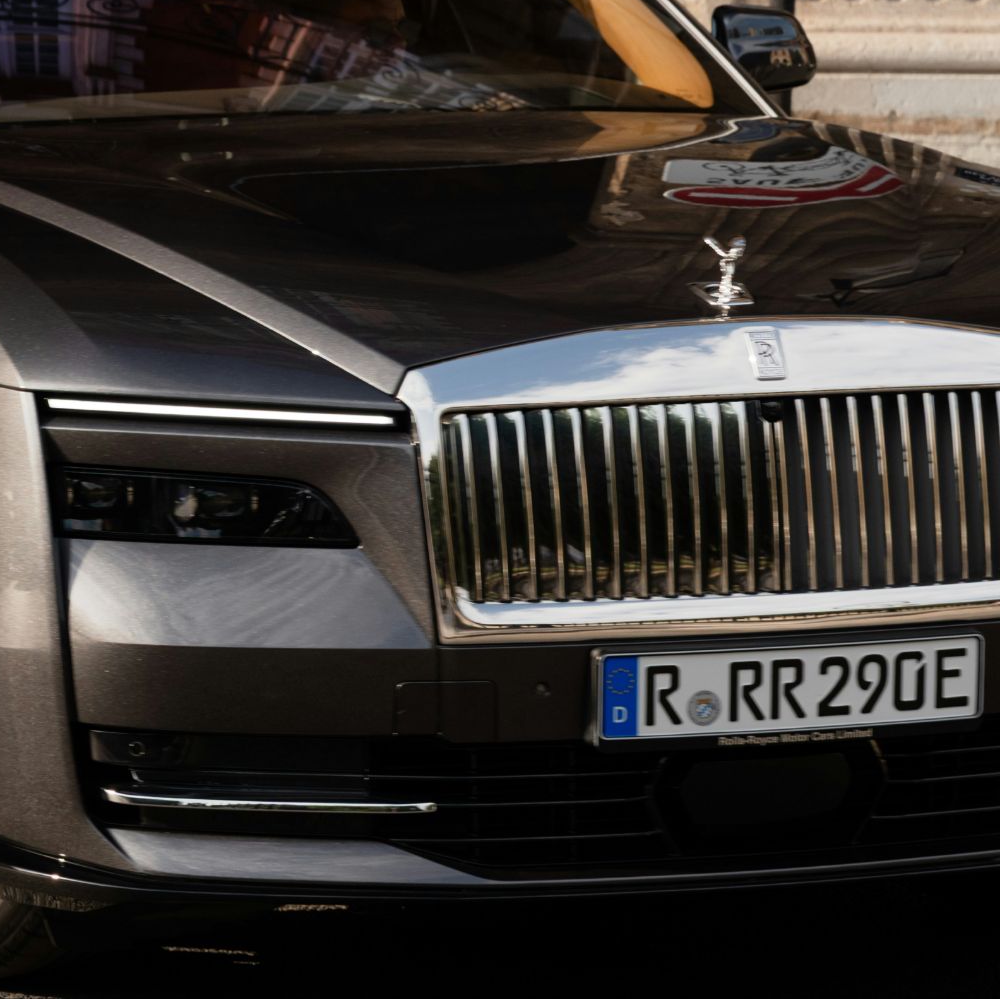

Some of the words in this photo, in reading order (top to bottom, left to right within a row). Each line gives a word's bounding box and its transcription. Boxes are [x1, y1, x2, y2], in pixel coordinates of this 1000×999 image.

[646, 664, 682, 727] R
[612, 706, 628, 724] D
[836, 728, 873, 740] Limited
